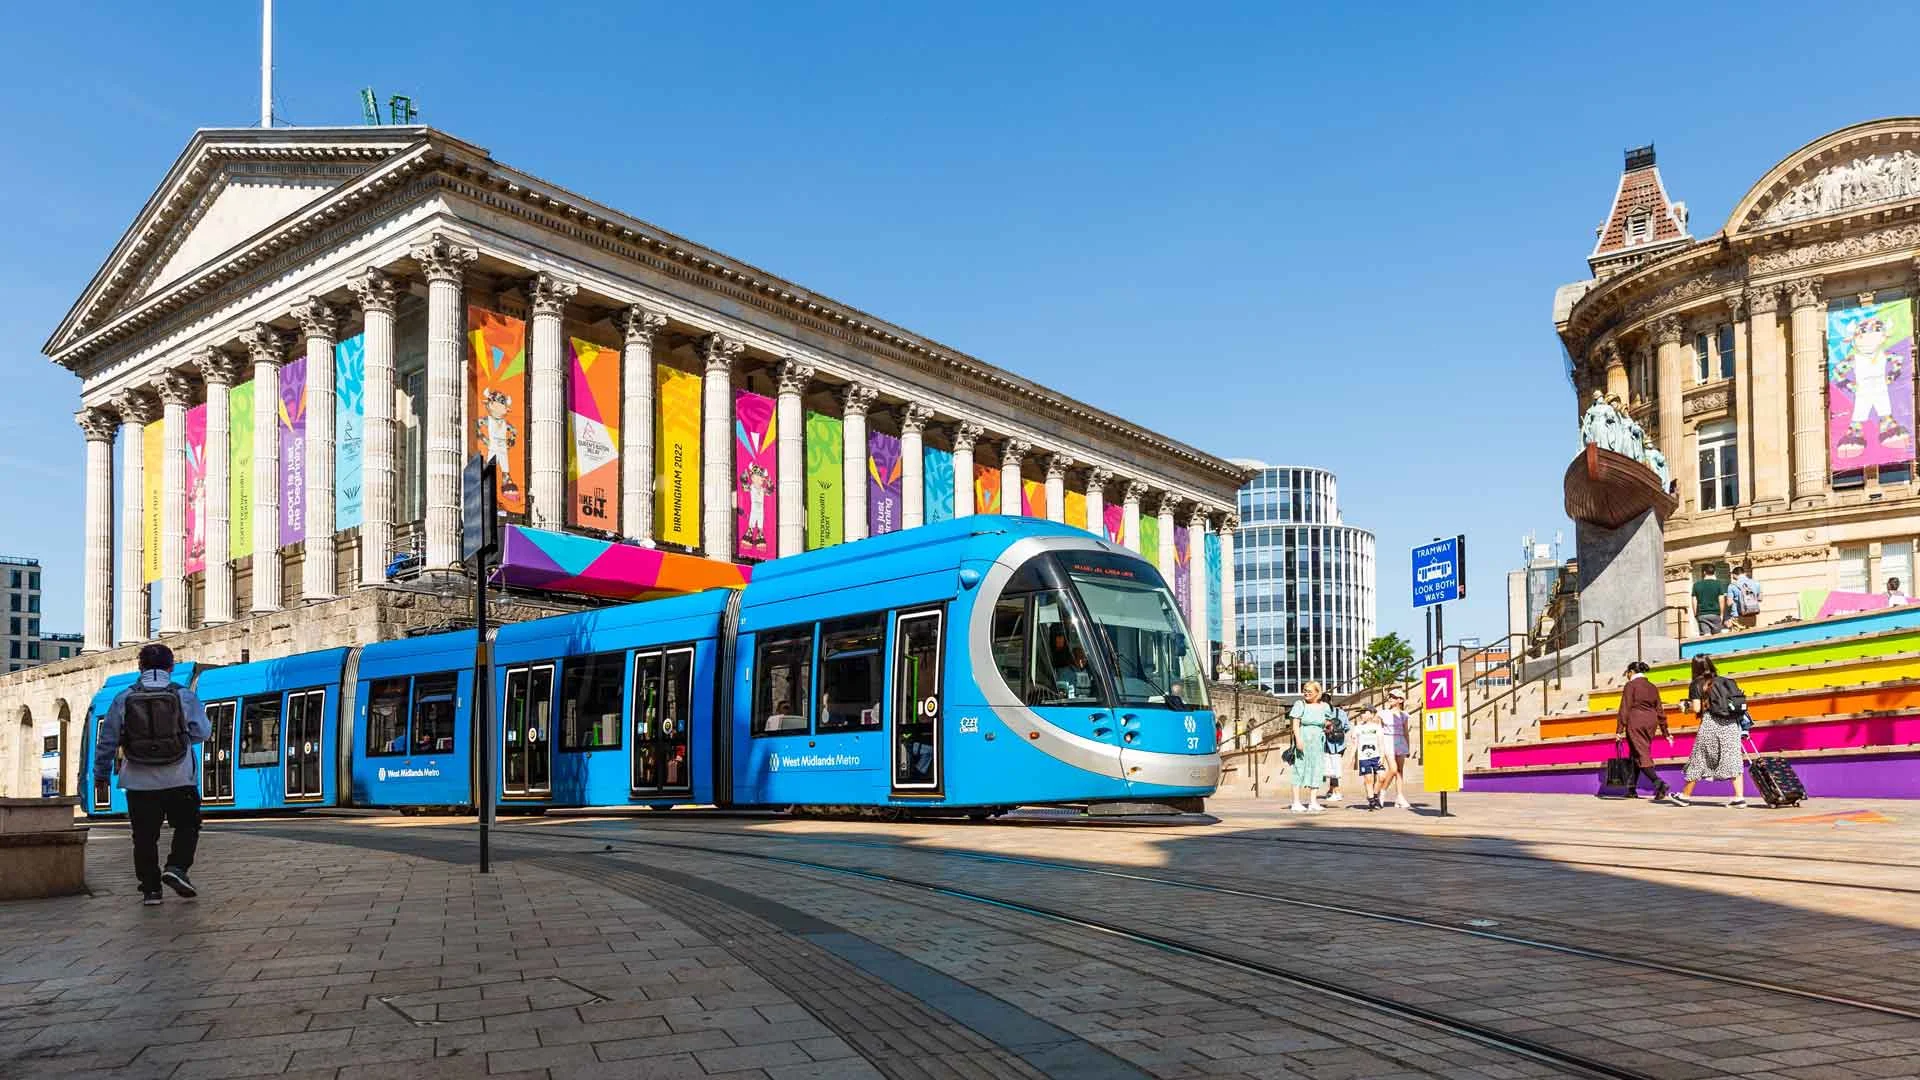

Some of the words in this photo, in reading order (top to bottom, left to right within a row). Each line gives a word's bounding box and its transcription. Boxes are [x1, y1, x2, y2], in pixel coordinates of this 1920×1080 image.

[287, 447, 295, 471] just
[674, 443, 683, 469] 2022
[294, 437, 303, 505] beginning
[287, 473, 295, 486] is
[287, 488, 295, 526] sport
[673, 470, 682, 533] BIRMINGHAM
[877, 500, 886, 523] just
[1417, 543, 1451, 558] TRAMWAY
[1415, 584, 1434, 596] LOOK
[1435, 580, 1455, 591] BOTH
[1425, 591, 1445, 602] WAYS
[1187, 737, 1199, 750] 37
[782, 755, 800, 767] West
[801, 754, 835, 767] Midlands
[835, 754, 860, 766] Metro
[387, 769, 400, 778] West
[400, 768, 424, 777] Midlands
[423, 768, 440, 777] Metro
